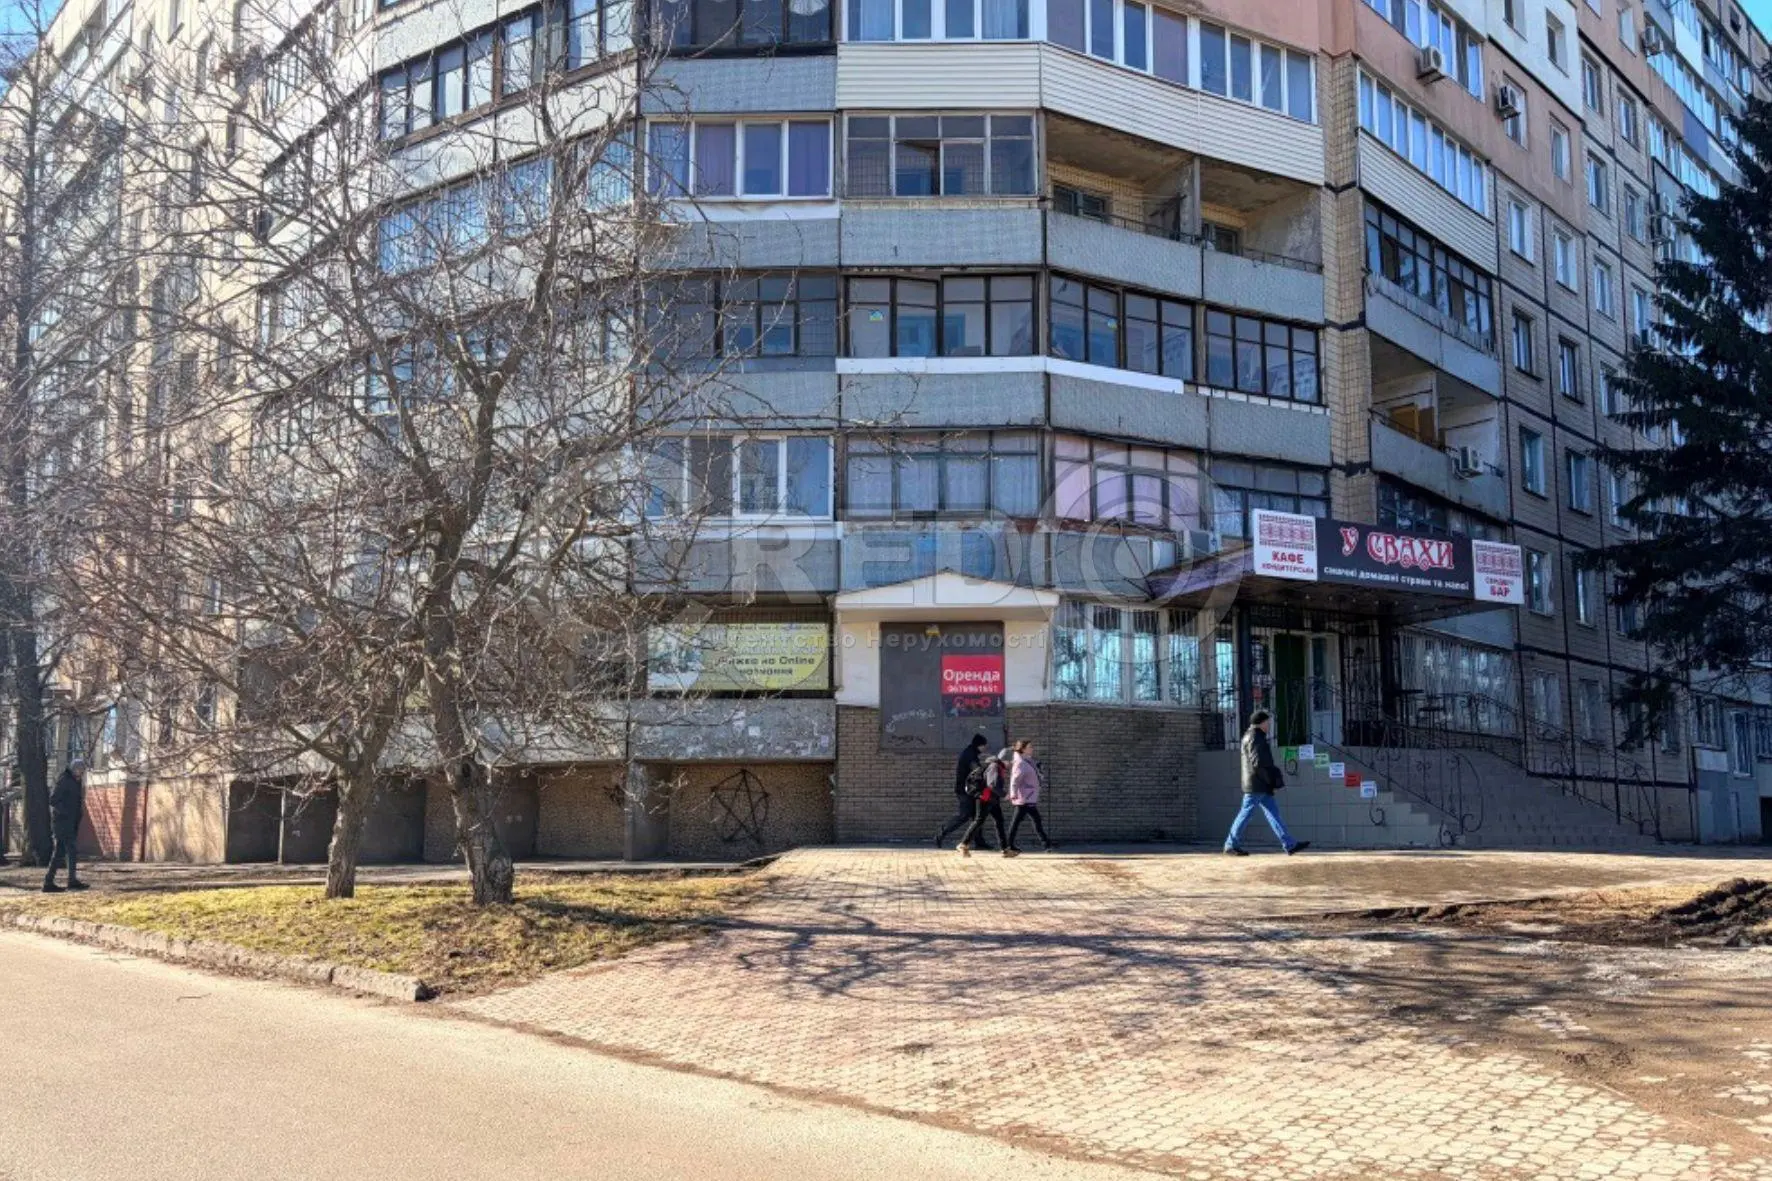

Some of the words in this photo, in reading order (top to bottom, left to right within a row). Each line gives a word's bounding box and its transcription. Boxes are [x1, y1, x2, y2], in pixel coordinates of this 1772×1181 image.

[1339, 526, 1359, 557] У
[1366, 532, 1454, 571] СВАХИ
[1271, 550, 1304, 564] КАФЕ
[1490, 585, 1511, 597] БАР
[943, 669, 1000, 684] Оренда
